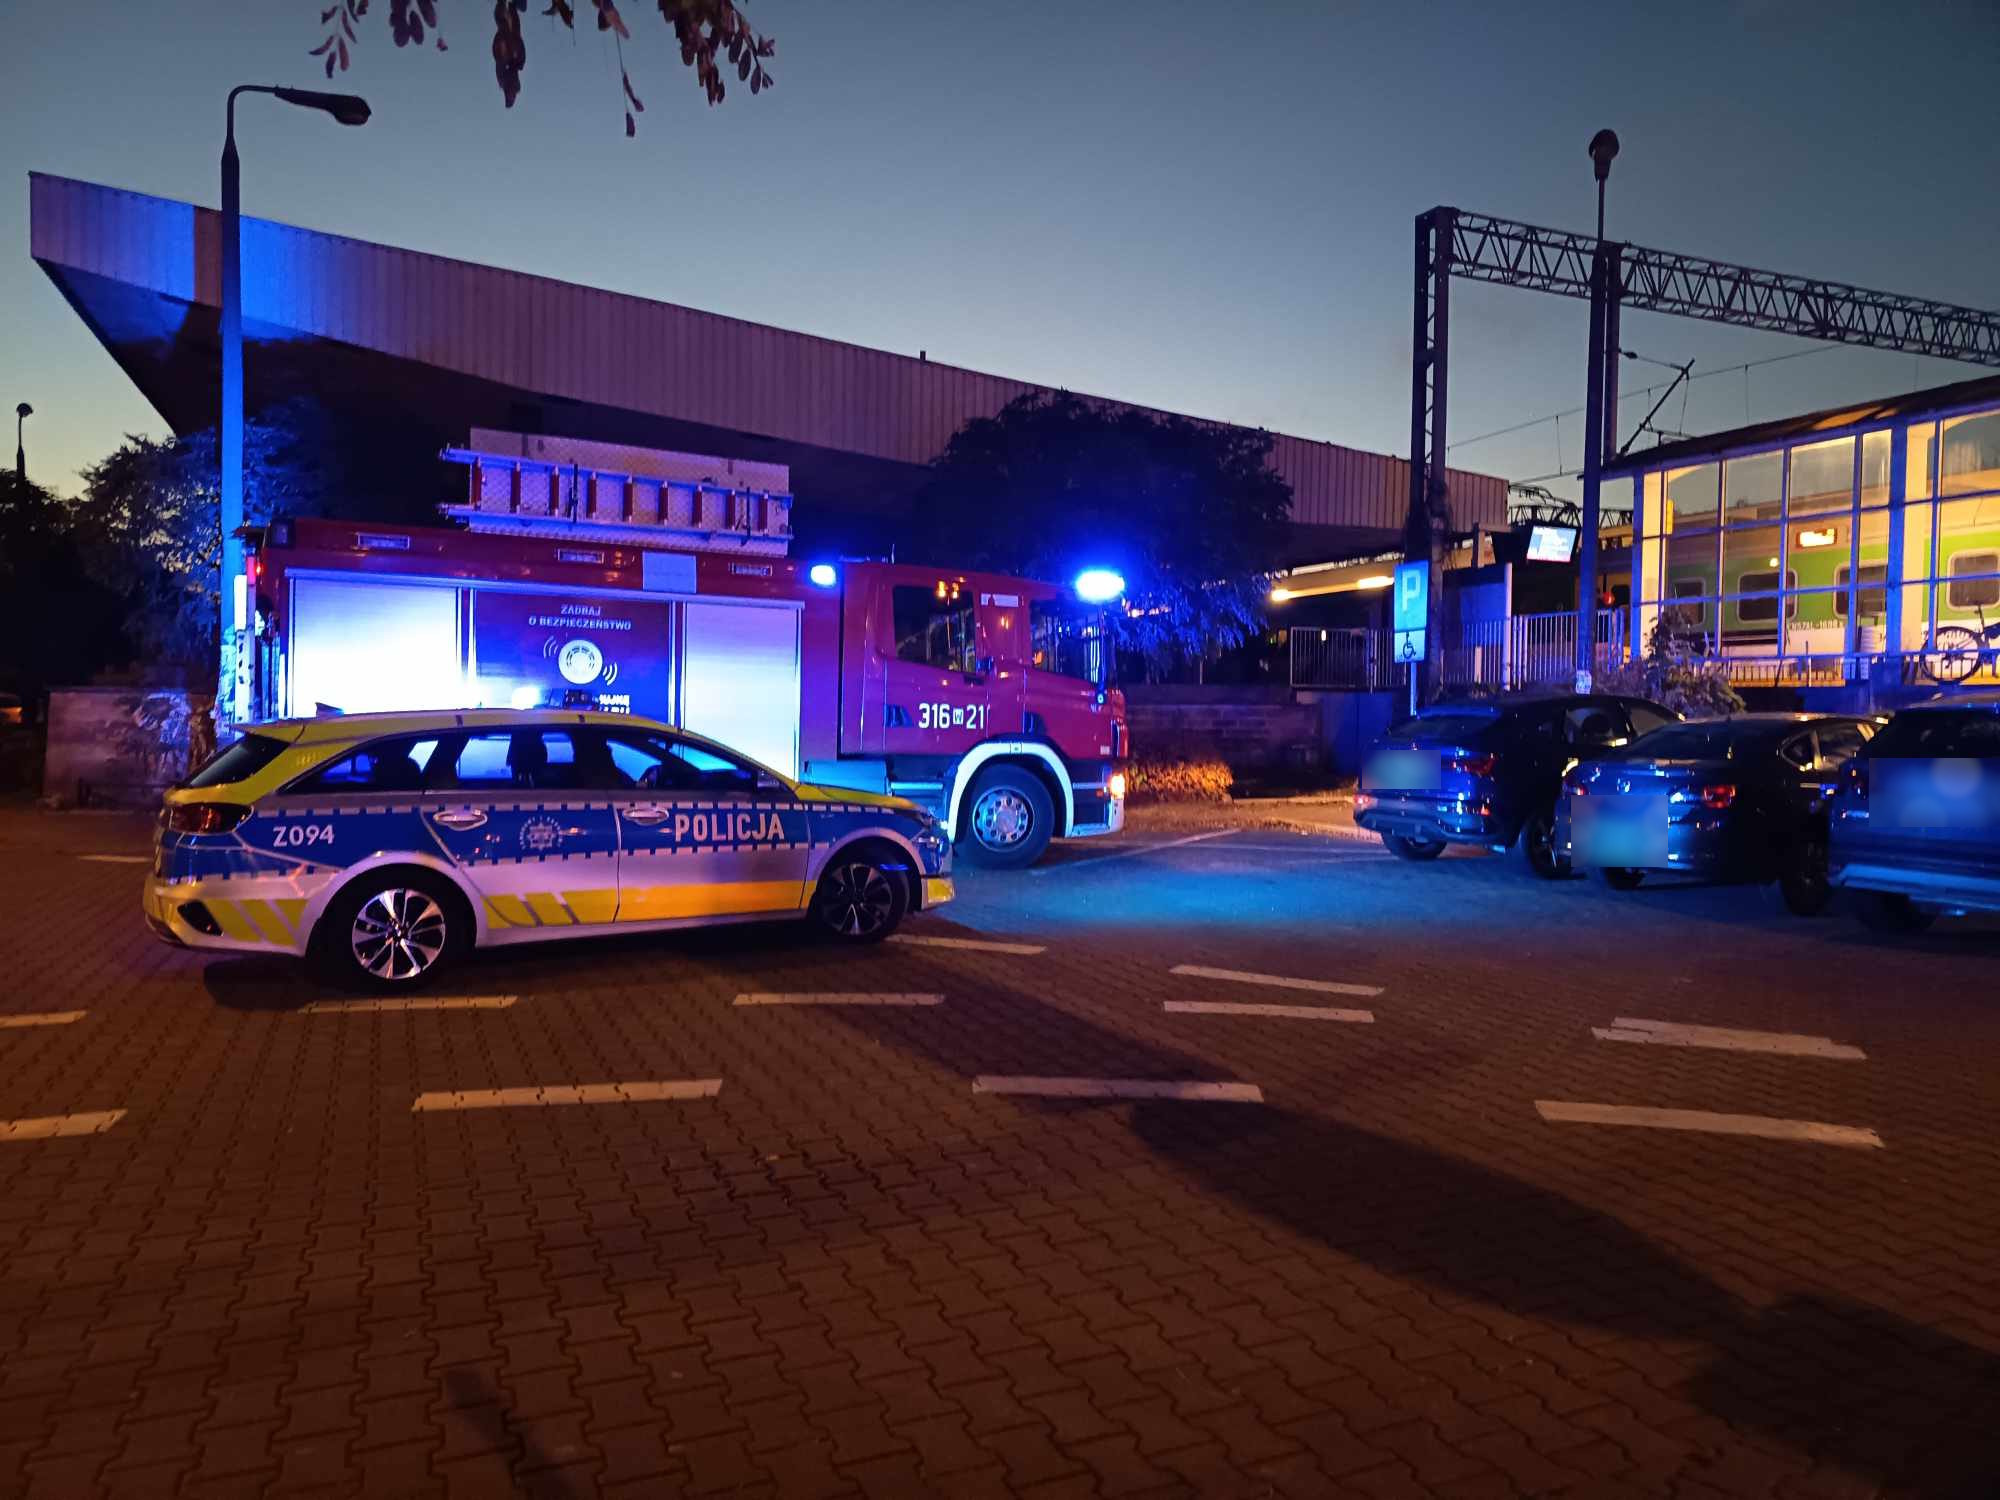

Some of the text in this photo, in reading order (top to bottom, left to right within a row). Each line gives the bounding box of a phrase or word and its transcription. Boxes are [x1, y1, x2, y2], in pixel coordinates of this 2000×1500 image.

[1402, 569, 1421, 612] P
[528, 616, 537, 626] O
[918, 703, 951, 729] 316
[966, 704, 984, 730] 21
[272, 824, 335, 847] Z094
[675, 813, 785, 842] POLICJA
